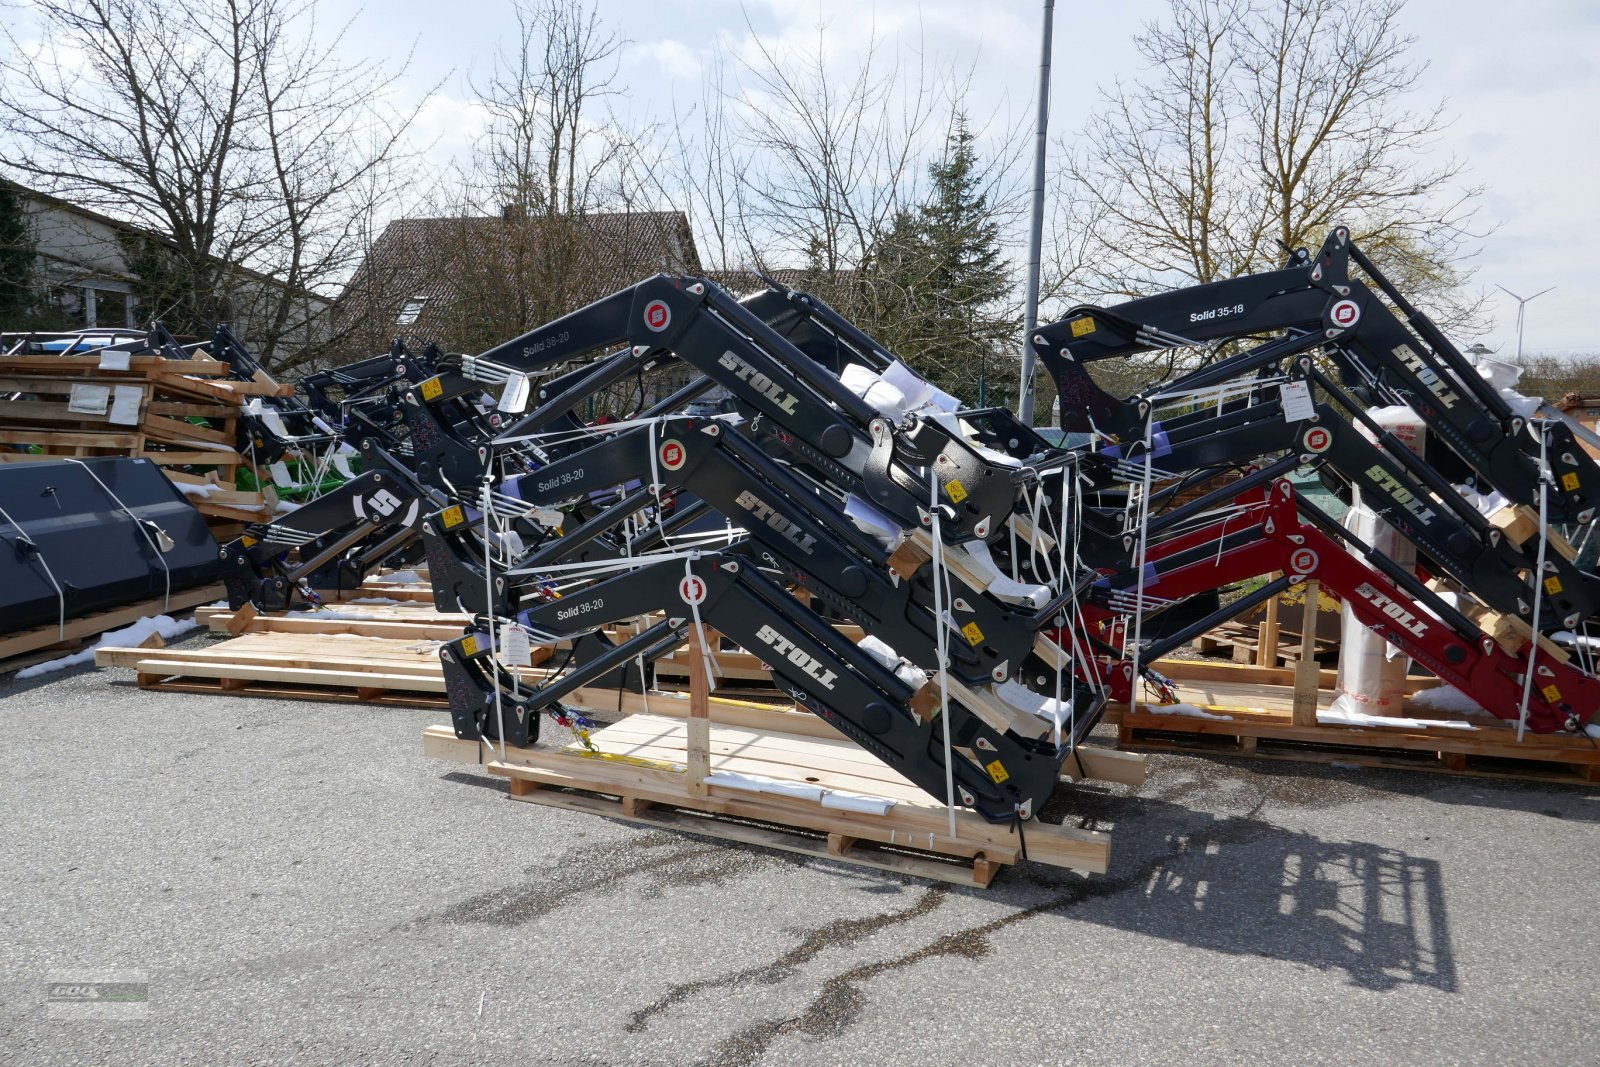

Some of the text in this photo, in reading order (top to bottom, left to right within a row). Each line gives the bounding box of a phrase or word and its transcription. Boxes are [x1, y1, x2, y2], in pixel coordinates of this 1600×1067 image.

[1190, 304, 1244, 322] Solid 35-18
[523, 331, 570, 357] Solid 38-20
[717, 350, 799, 416] STOLL
[1391, 343, 1460, 409] STOLL
[538, 468, 584, 492] Solid 38-20
[1364, 464, 1436, 526] STOLL
[735, 490, 818, 555] STOLL
[557, 598, 604, 620] Solid 38-20
[1355, 582, 1429, 639] STOLL
[755, 624, 838, 691] STOLL
